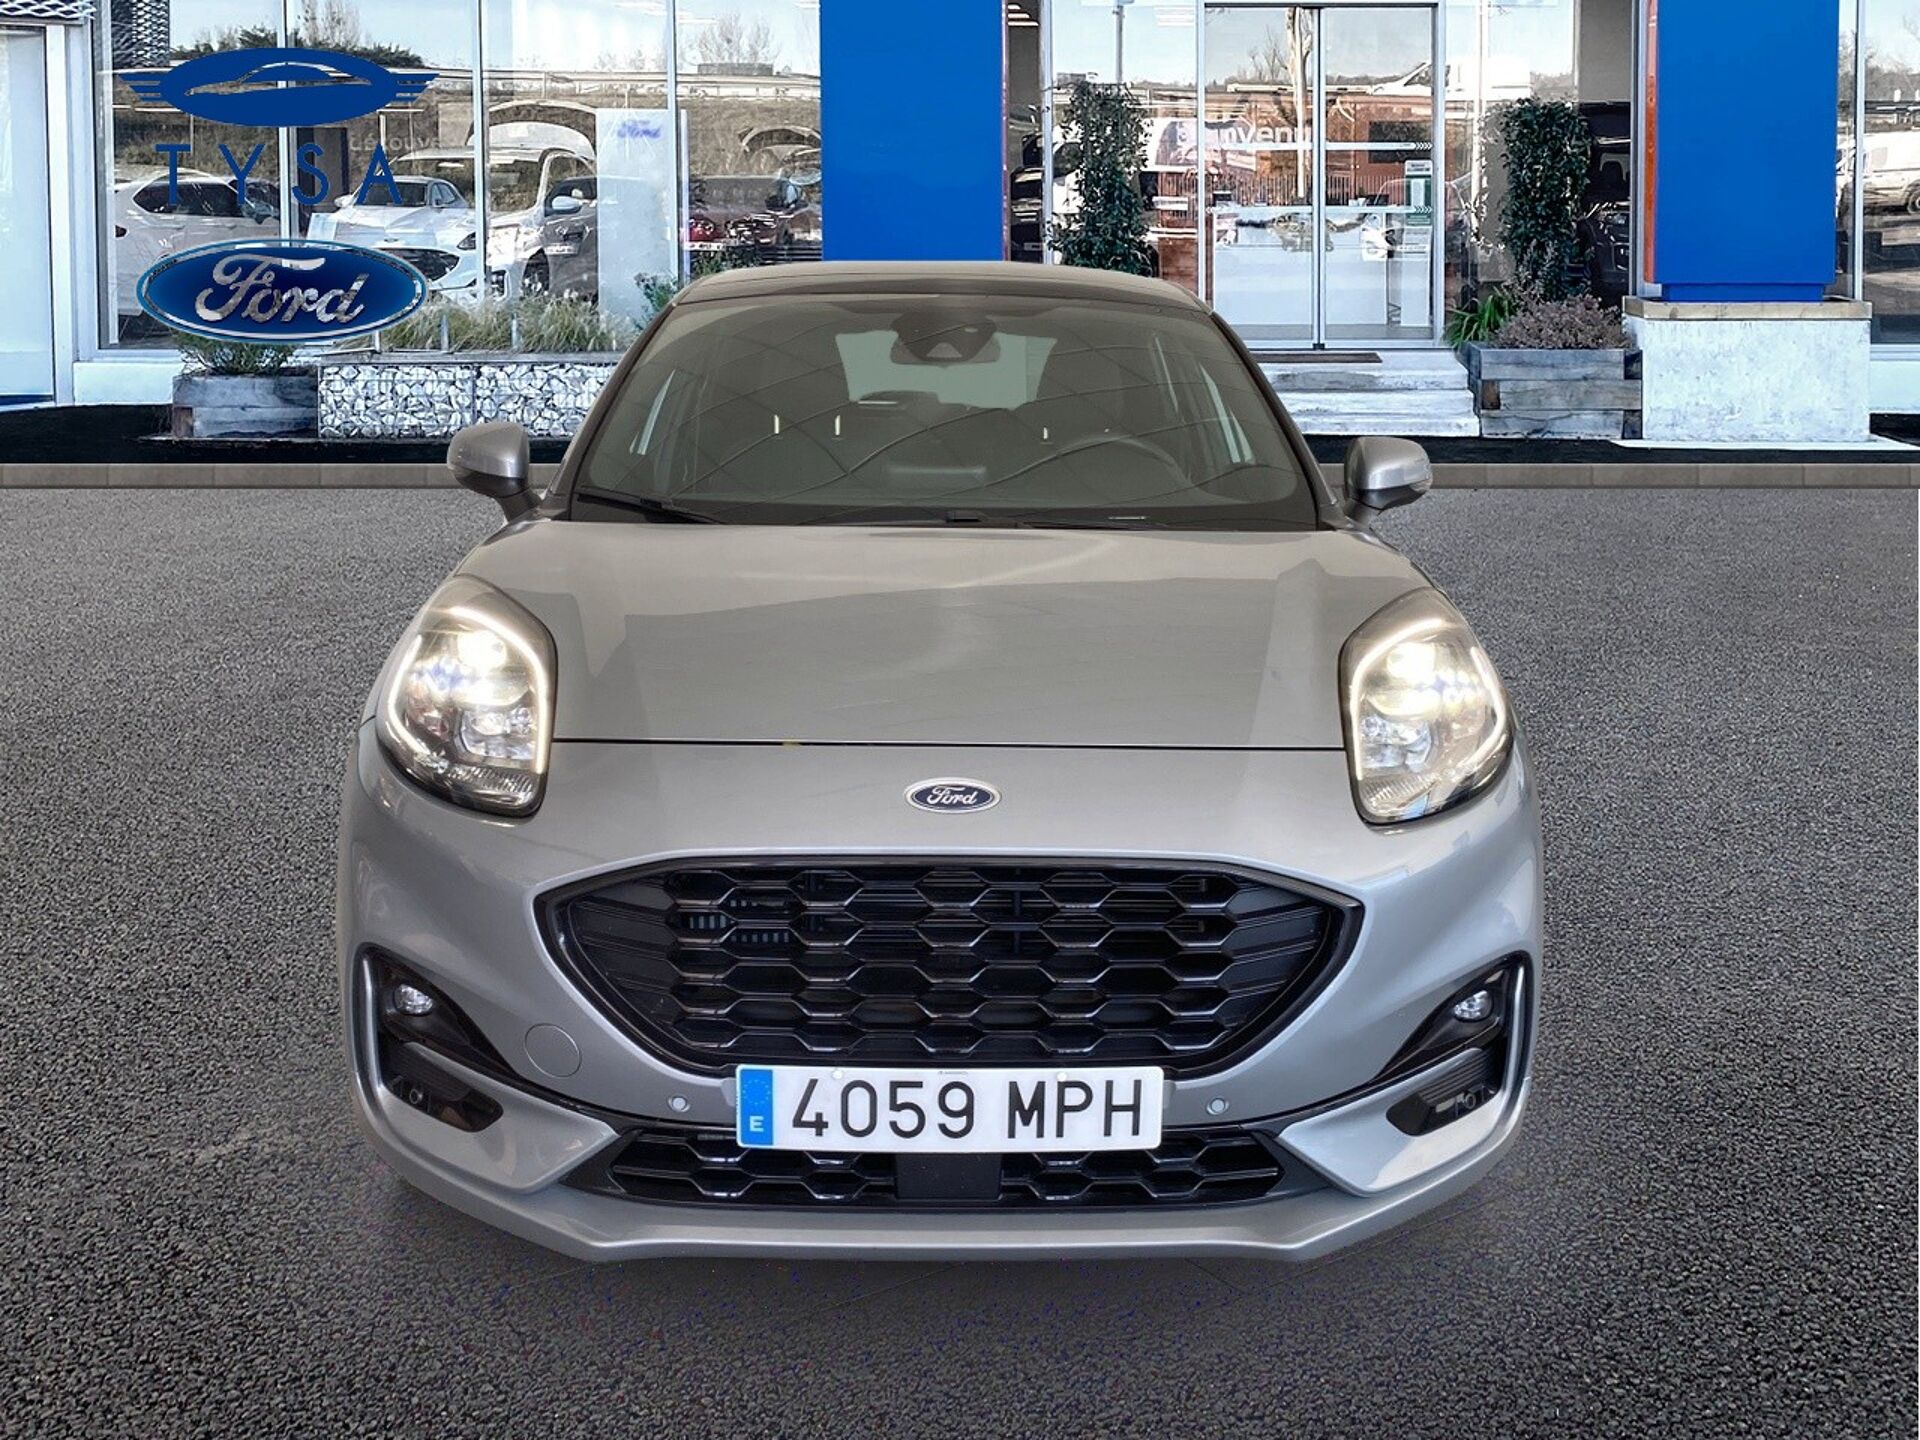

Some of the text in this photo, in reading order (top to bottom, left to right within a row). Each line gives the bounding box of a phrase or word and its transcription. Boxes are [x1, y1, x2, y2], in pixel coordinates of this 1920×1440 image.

[926, 785, 979, 805] Ford
[792, 1078, 1142, 1139] 4059 MPH
[749, 1115, 765, 1133] E
